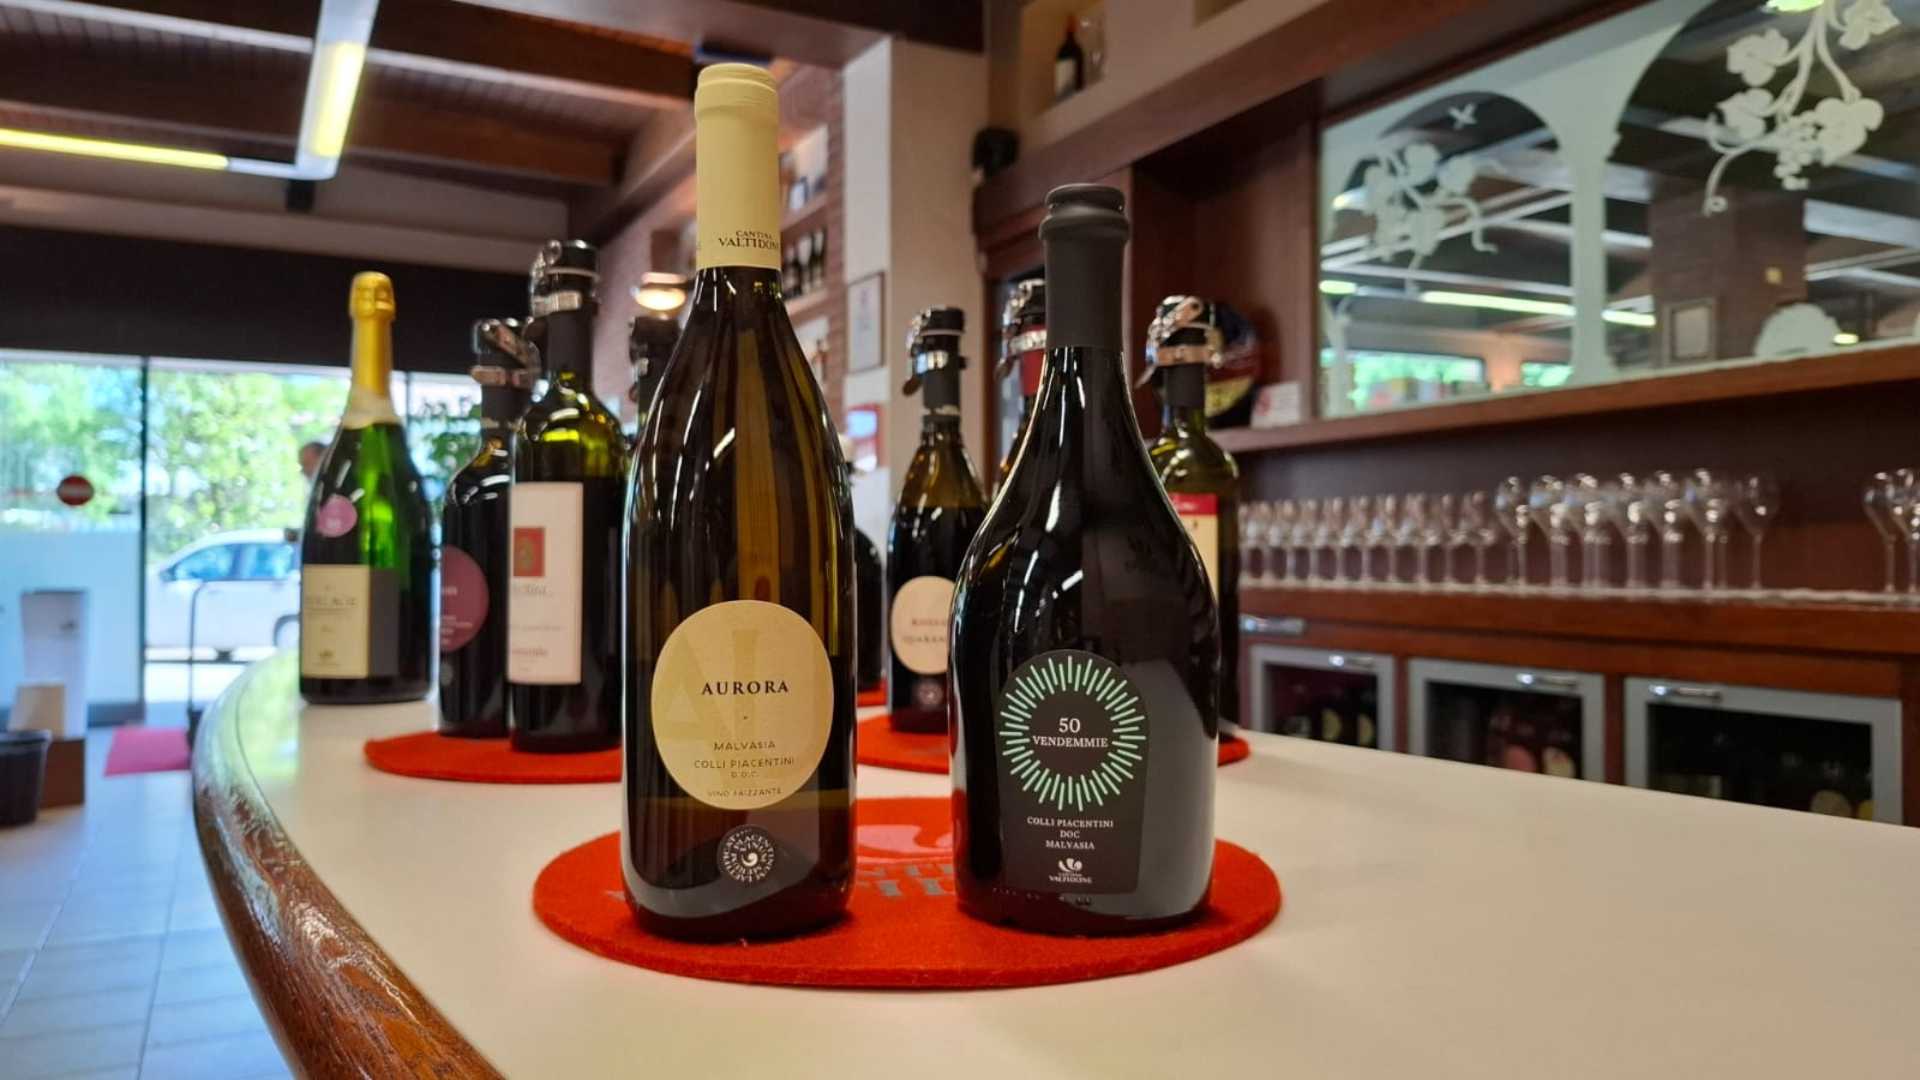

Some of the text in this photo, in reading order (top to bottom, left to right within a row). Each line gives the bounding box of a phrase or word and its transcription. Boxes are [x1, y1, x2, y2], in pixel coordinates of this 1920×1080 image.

[701, 680, 789, 695] AURORA
[1058, 717, 1081, 734] 50
[713, 741, 776, 752] MALVASIA
[1032, 735, 1109, 748] VENDEMMIE
[694, 757, 794, 769] COLLI PIACENTINI
[1026, 815, 1115, 829] COLLI PIACENTINI
[1059, 829, 1081, 840] DOC
[1045, 839, 1096, 851] MALVASIA
